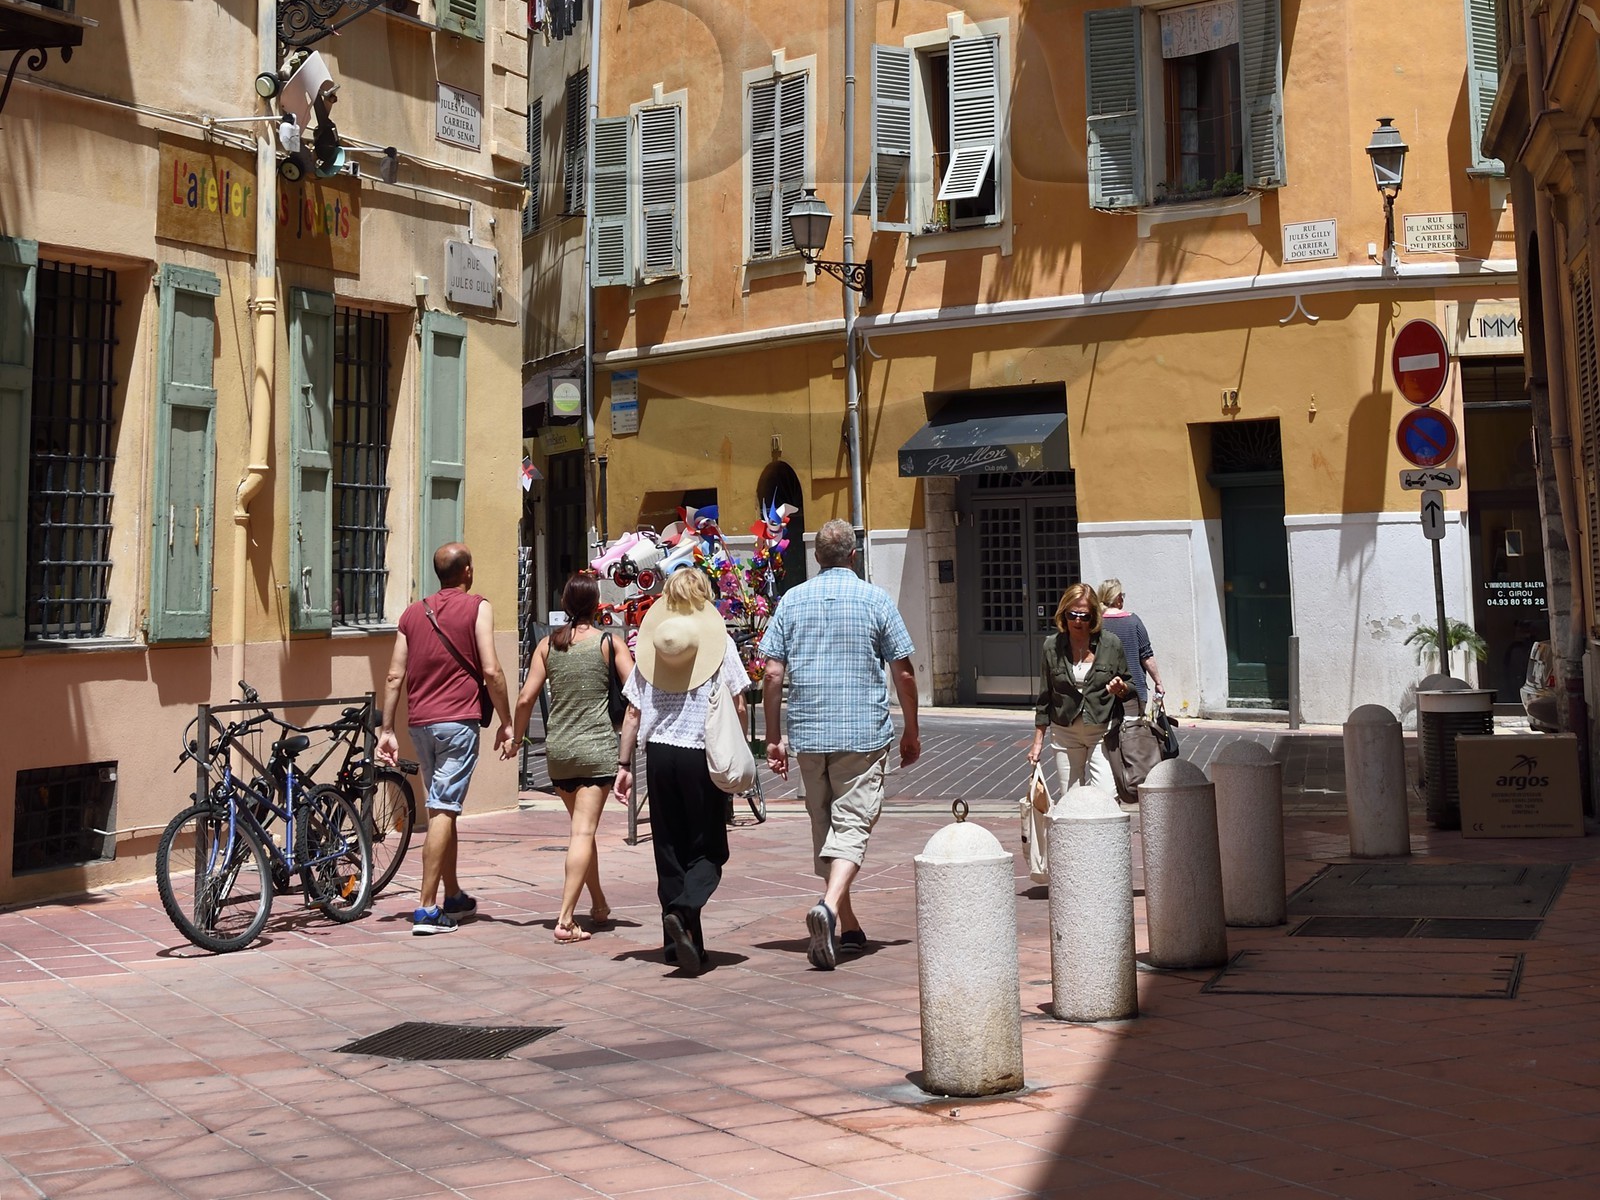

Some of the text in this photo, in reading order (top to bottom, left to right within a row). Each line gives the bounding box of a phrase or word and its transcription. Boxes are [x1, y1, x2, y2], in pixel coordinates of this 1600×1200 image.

[453, 91, 465, 103] RUE
[440, 98, 477, 118] JULES GILLY
[443, 115, 474, 132] CARRIERA
[457, 131, 475, 143] SENAT
[173, 159, 250, 218] L'atelier
[296, 187, 350, 239] jouets
[1289, 233, 1309, 241] JULES
[1415, 234, 1458, 242] CARRIERA
[1293, 241, 1328, 250] CARRIERA
[1427, 241, 1464, 249] PRESOUN
[1309, 248, 1330, 256] SENAT
[467, 258, 480, 271] RUE
[451, 276, 494, 294] JULES GILLY
[1223, 390, 1238, 407] 12
[926, 445, 1007, 473] Papillon
[1487, 598, 1509, 606] 04.93
[1510, 598, 1520, 606] 80
[1496, 775, 1549, 790] argos
